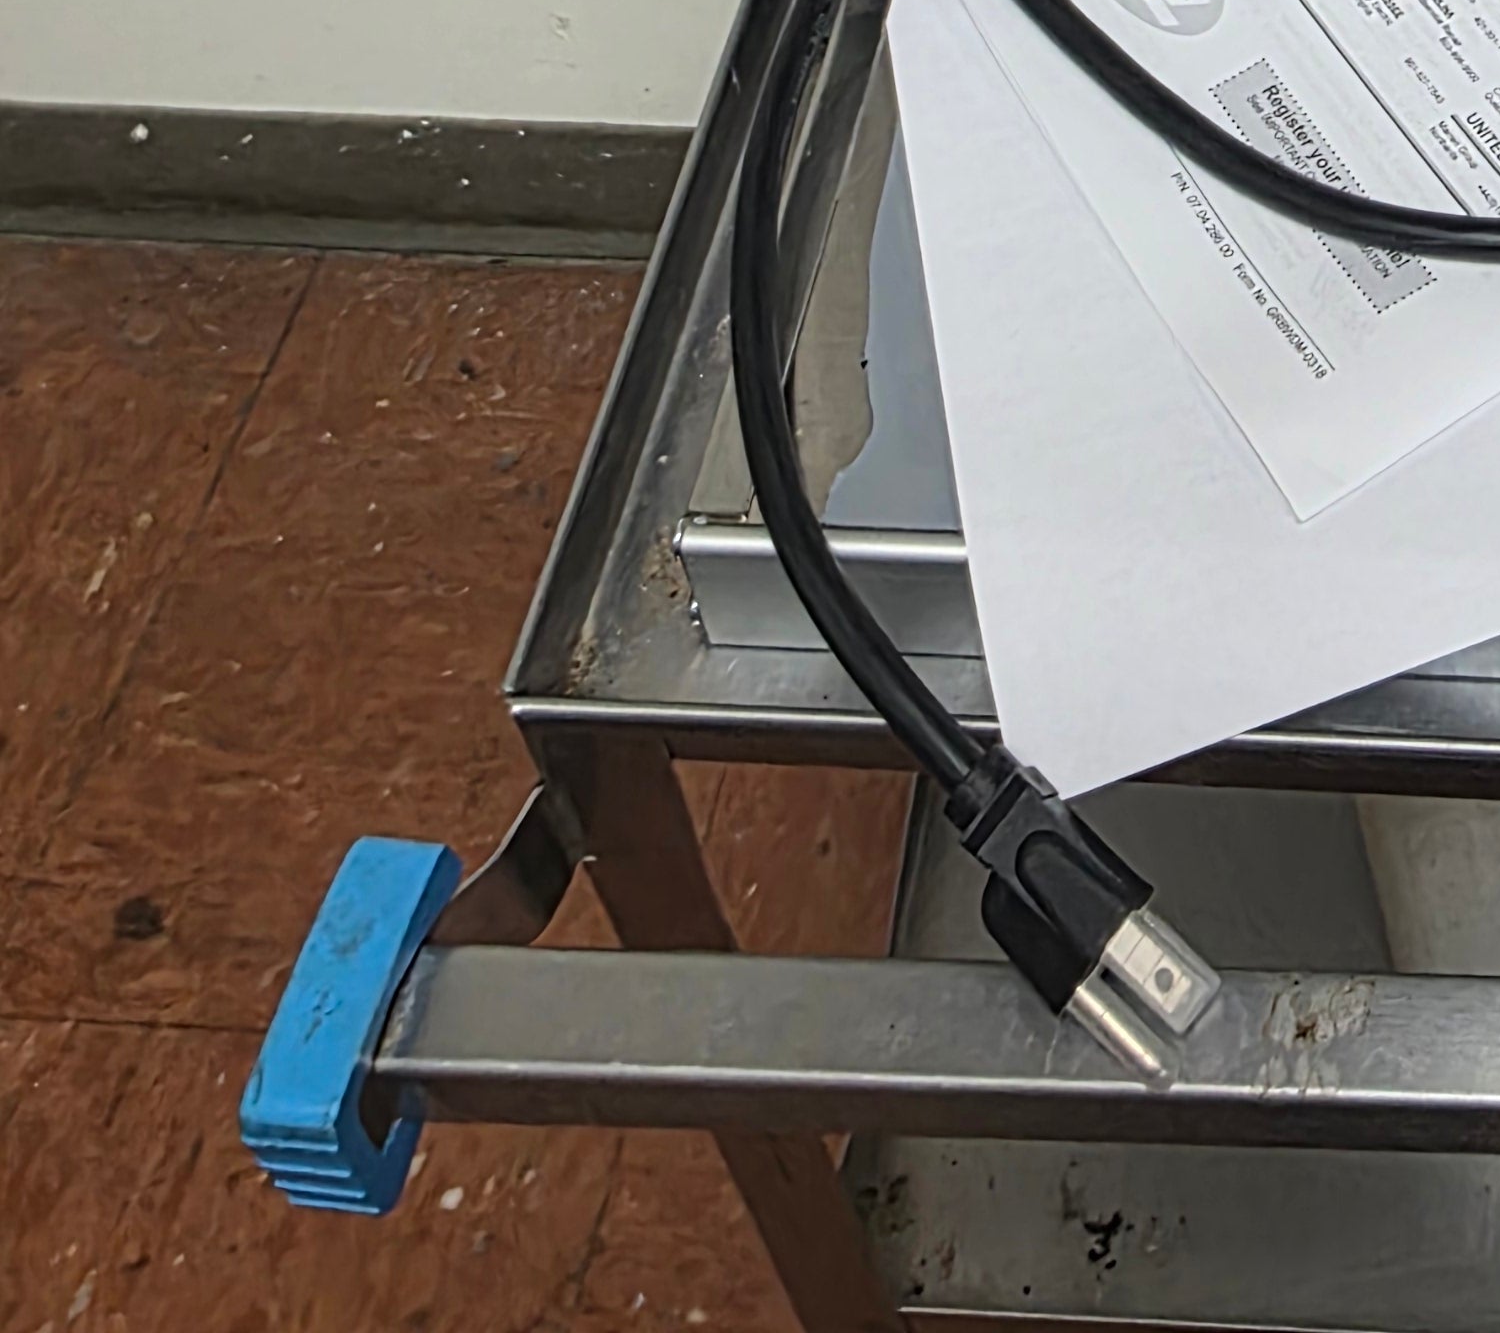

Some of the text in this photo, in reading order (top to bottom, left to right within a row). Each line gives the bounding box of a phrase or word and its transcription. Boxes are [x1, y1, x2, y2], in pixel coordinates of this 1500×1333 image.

[1246, 94, 1309, 172] See IMPORTANT
[1261, 84, 1344, 189] Register your
